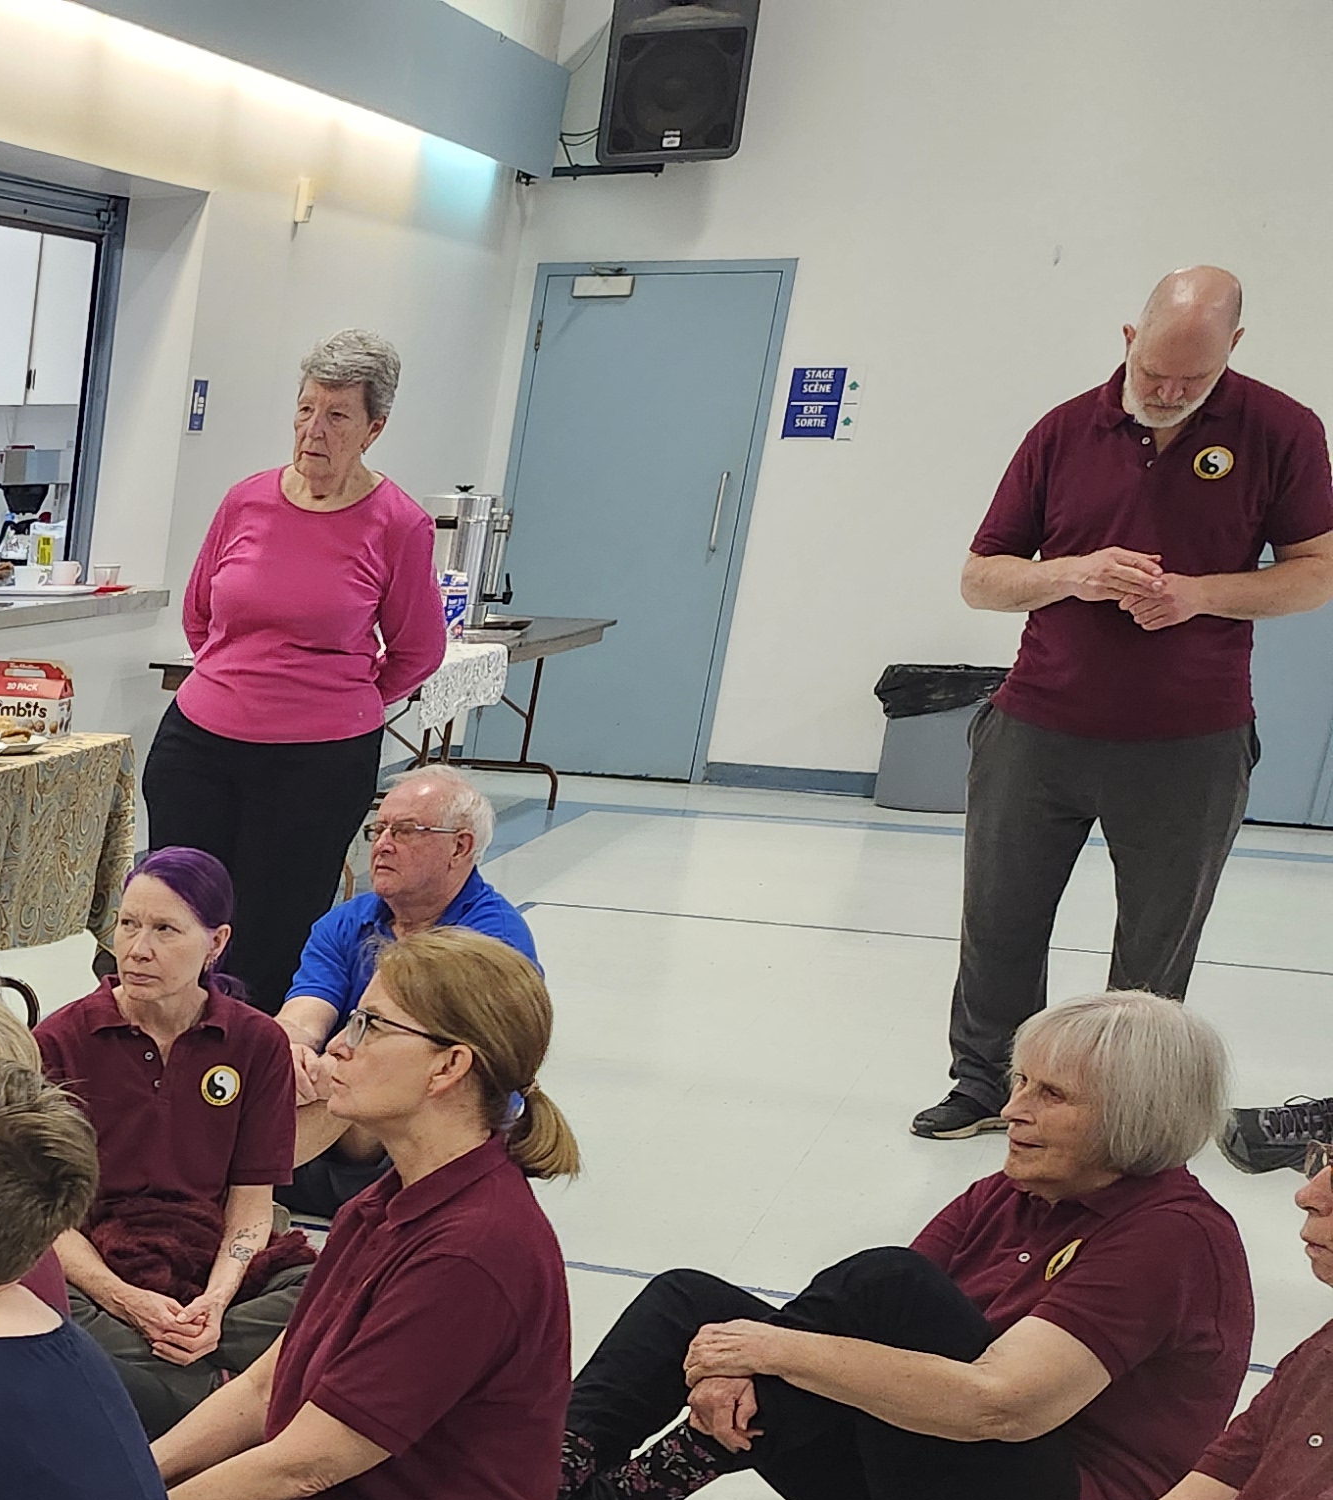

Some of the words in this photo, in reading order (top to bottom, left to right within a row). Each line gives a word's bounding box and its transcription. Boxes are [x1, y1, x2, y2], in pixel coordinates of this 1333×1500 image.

[805, 369, 835, 379] STAGE
[802, 381, 832, 393] SCÈNE
[803, 405, 823, 414] EXIT
[795, 418, 826, 427] SORTIE
[6, 682, 16, 690] 20
[17, 683, 39, 691] PACK
